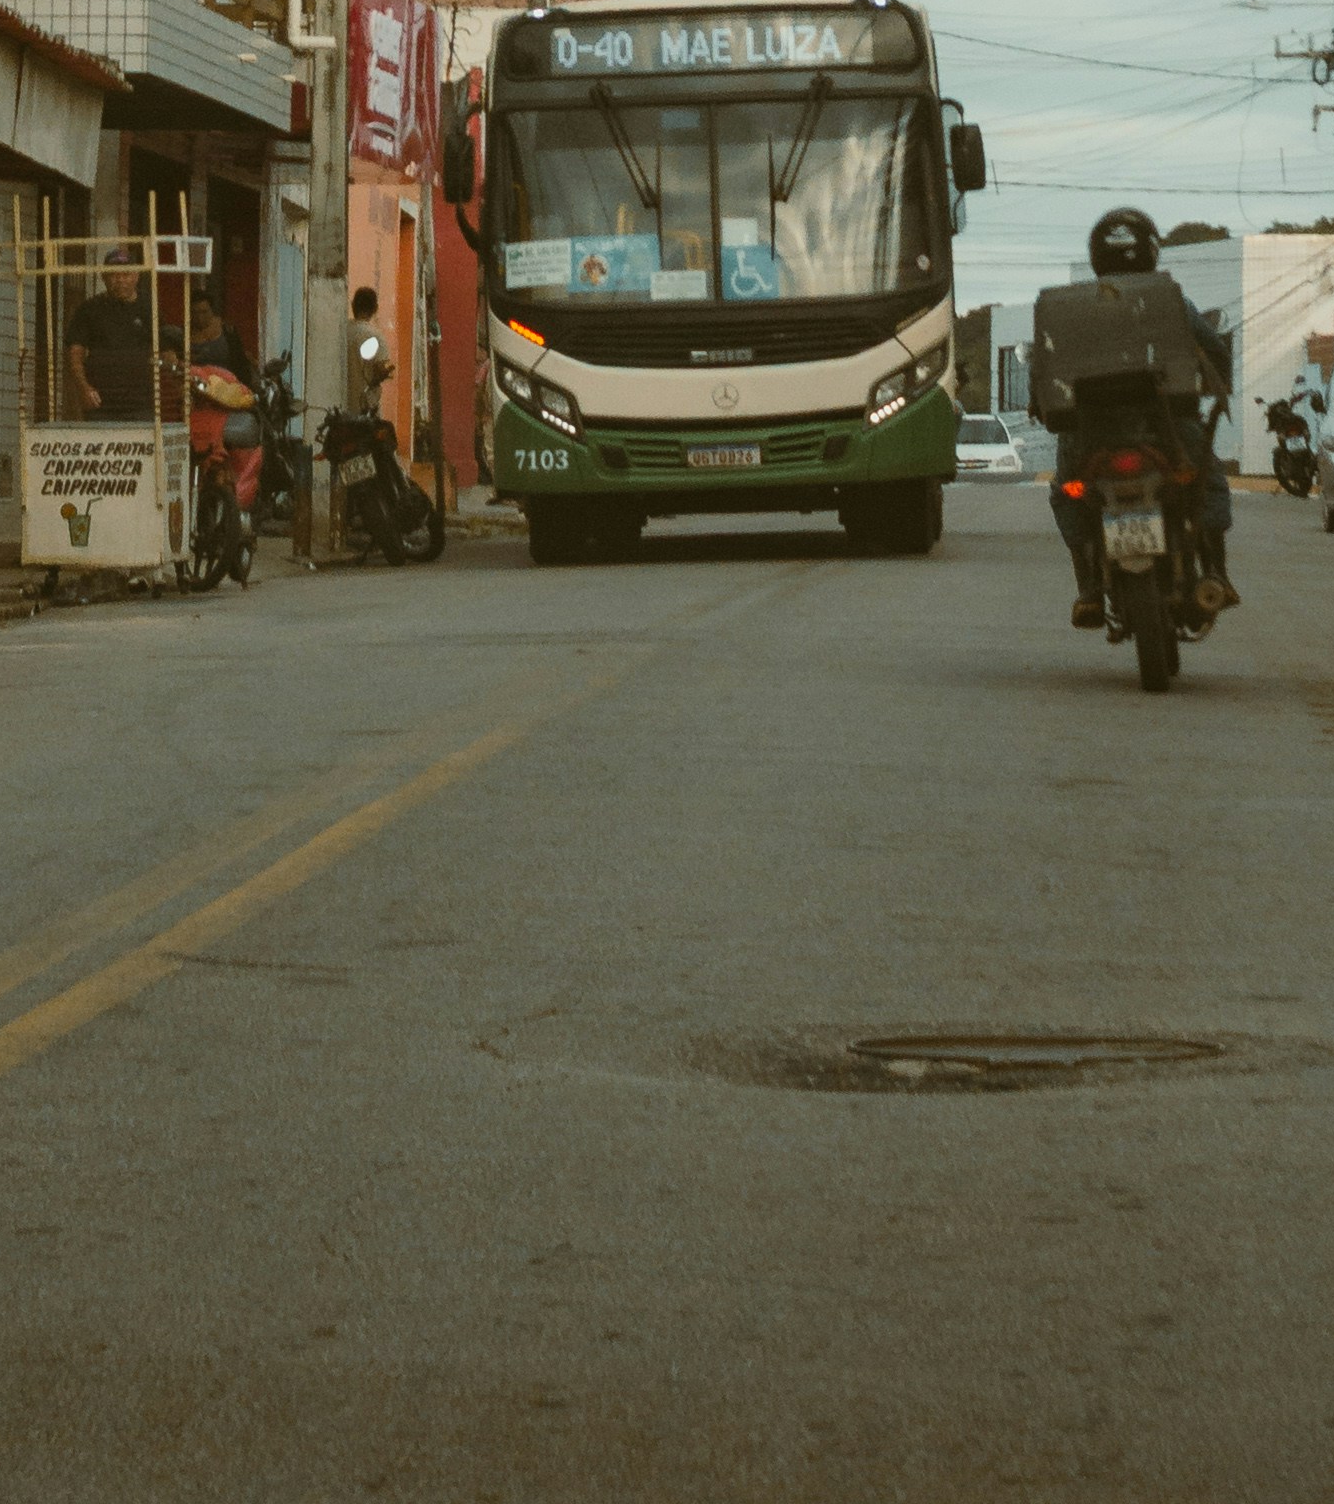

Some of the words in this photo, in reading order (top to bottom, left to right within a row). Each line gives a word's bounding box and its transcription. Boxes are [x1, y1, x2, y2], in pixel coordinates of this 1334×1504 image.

[660, 27, 733, 65] MAE
[744, 25, 843, 63] LUIZA
[29, 442, 82, 457] SUCOS
[84, 442, 104, 456] DE
[104, 442, 155, 456] FRUTAS
[43, 459, 144, 476] CAIPIROSCA
[515, 449, 570, 471] 7103
[40, 479, 139, 496] CAIPIRINHA
